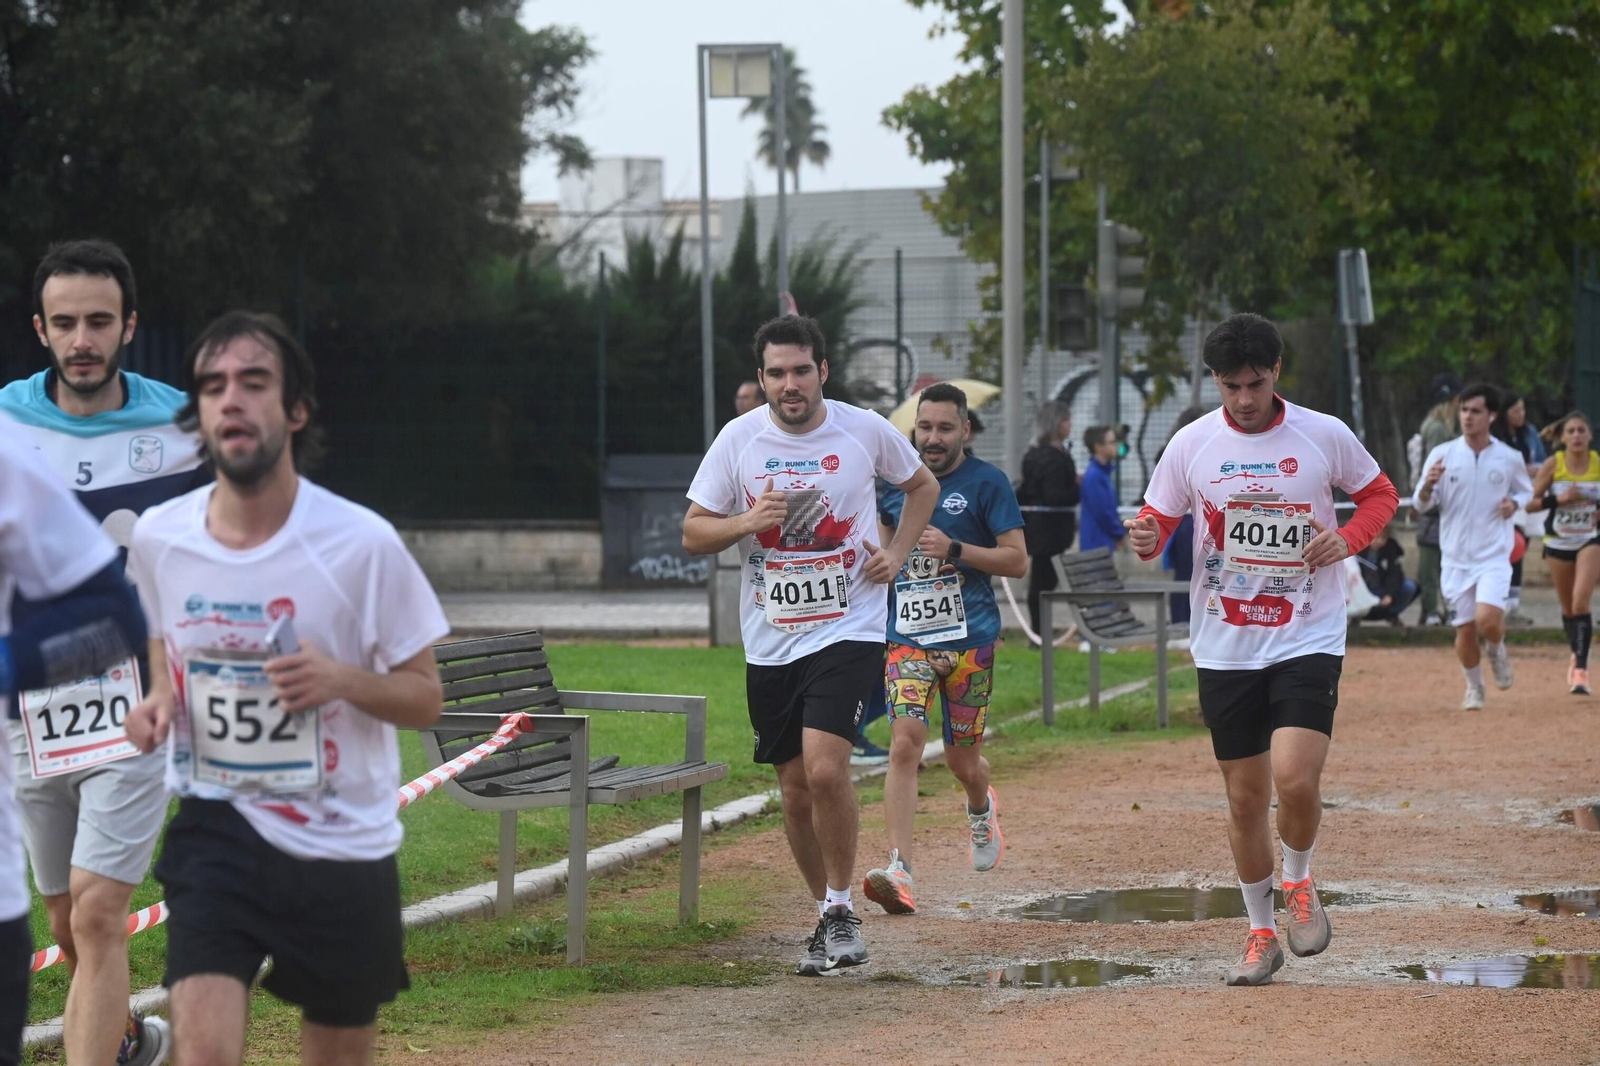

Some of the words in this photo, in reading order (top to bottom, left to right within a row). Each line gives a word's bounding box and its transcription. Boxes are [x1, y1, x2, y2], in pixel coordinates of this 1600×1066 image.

[75, 461, 92, 486] 5
[822, 458, 838, 469] aje
[1280, 462, 1298, 473] aje
[942, 498, 968, 508] SPG
[1229, 521, 1299, 548] 4014
[770, 577, 834, 605] 4011
[900, 596, 953, 622] 4554
[1239, 603, 1282, 614] RUNNNG
[1246, 613, 1279, 623] SERIES
[37, 695, 130, 741] 1220
[207, 696, 298, 743] 552
